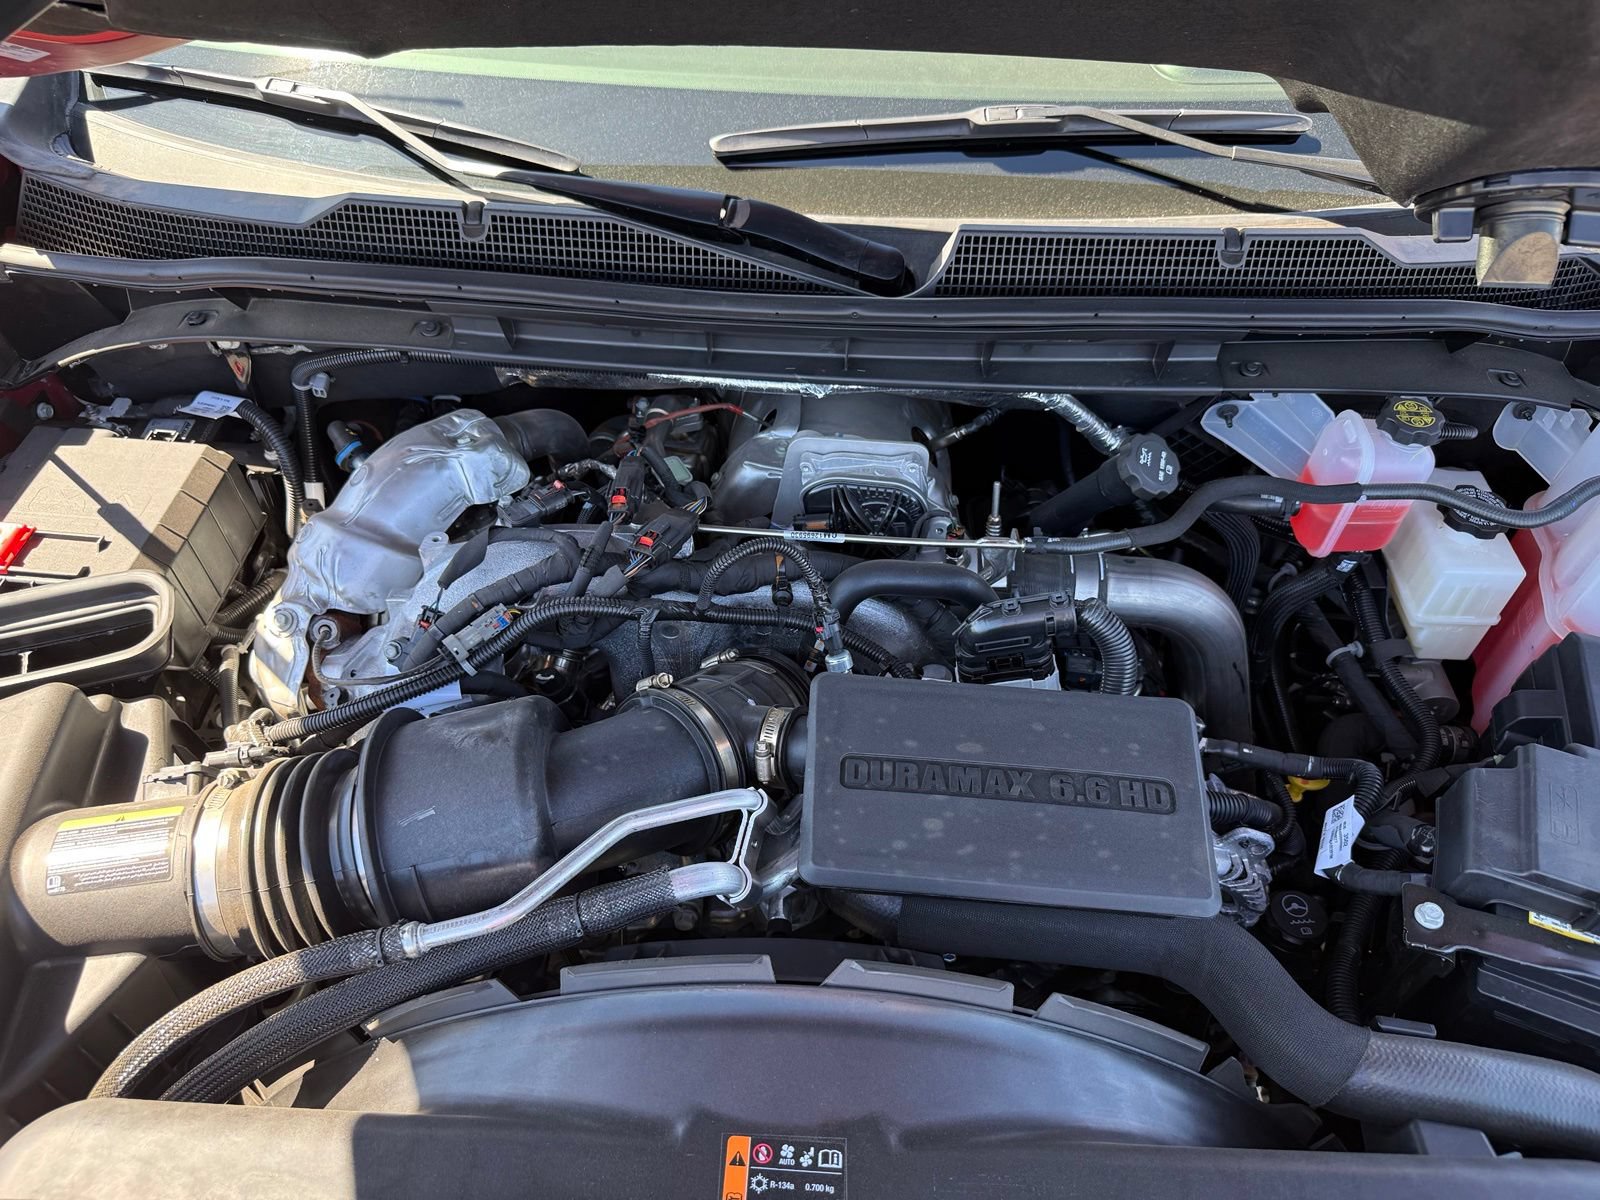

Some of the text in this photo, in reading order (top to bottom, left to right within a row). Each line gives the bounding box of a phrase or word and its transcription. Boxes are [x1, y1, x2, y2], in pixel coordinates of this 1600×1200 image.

[844, 758, 1170, 811] DURAMAX 6.6 HD
[769, 1181, 835, 1194] R-134a 0.700 kg
